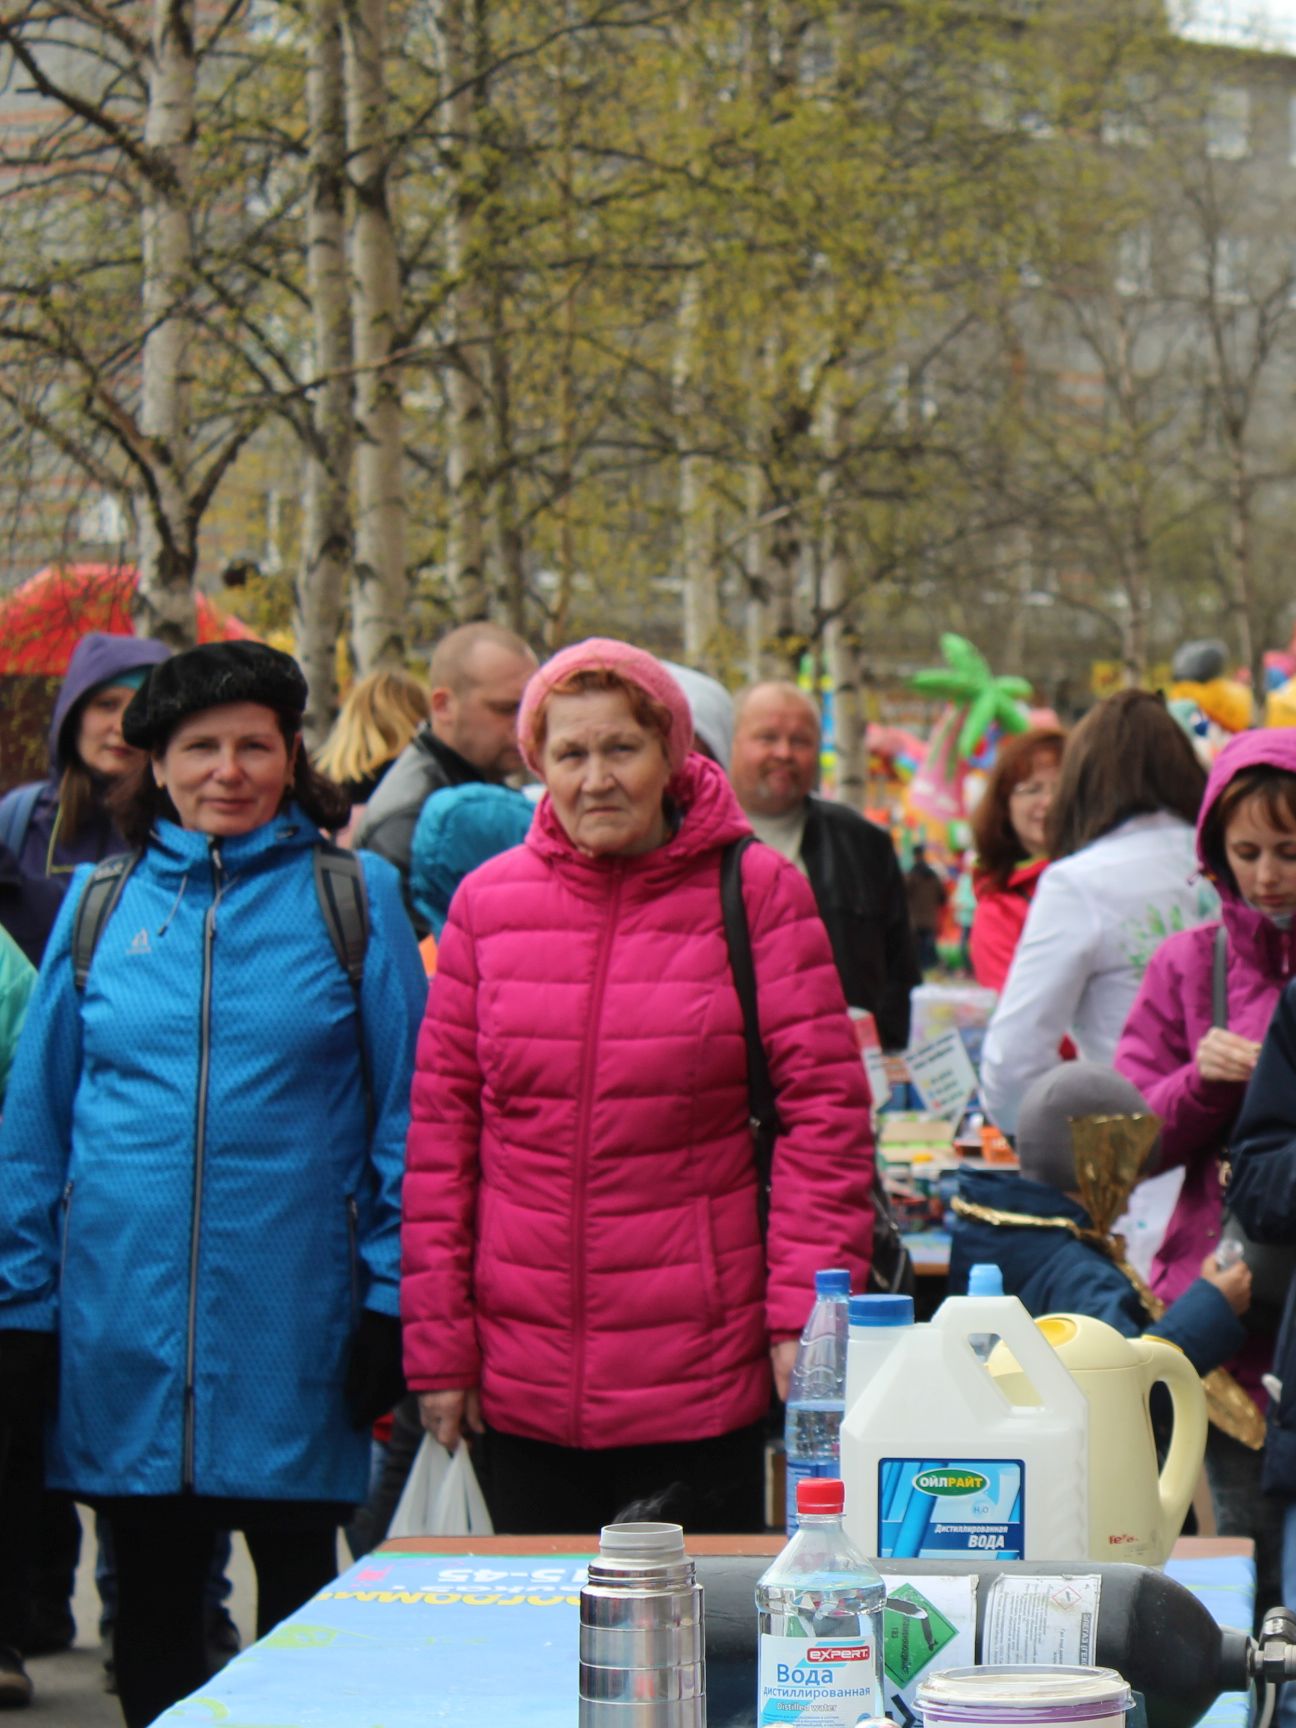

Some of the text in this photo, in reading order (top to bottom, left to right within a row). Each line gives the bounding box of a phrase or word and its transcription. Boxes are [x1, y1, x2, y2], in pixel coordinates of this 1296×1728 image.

[919, 1475, 984, 1488] ОЙЛРАЙТ
[934, 1524, 1009, 1535] Дистиллированная
[968, 1535, 1006, 1550] ВОДА
[776, 1663, 834, 1686] Вода
[763, 1686, 871, 1700] дистиллированная
